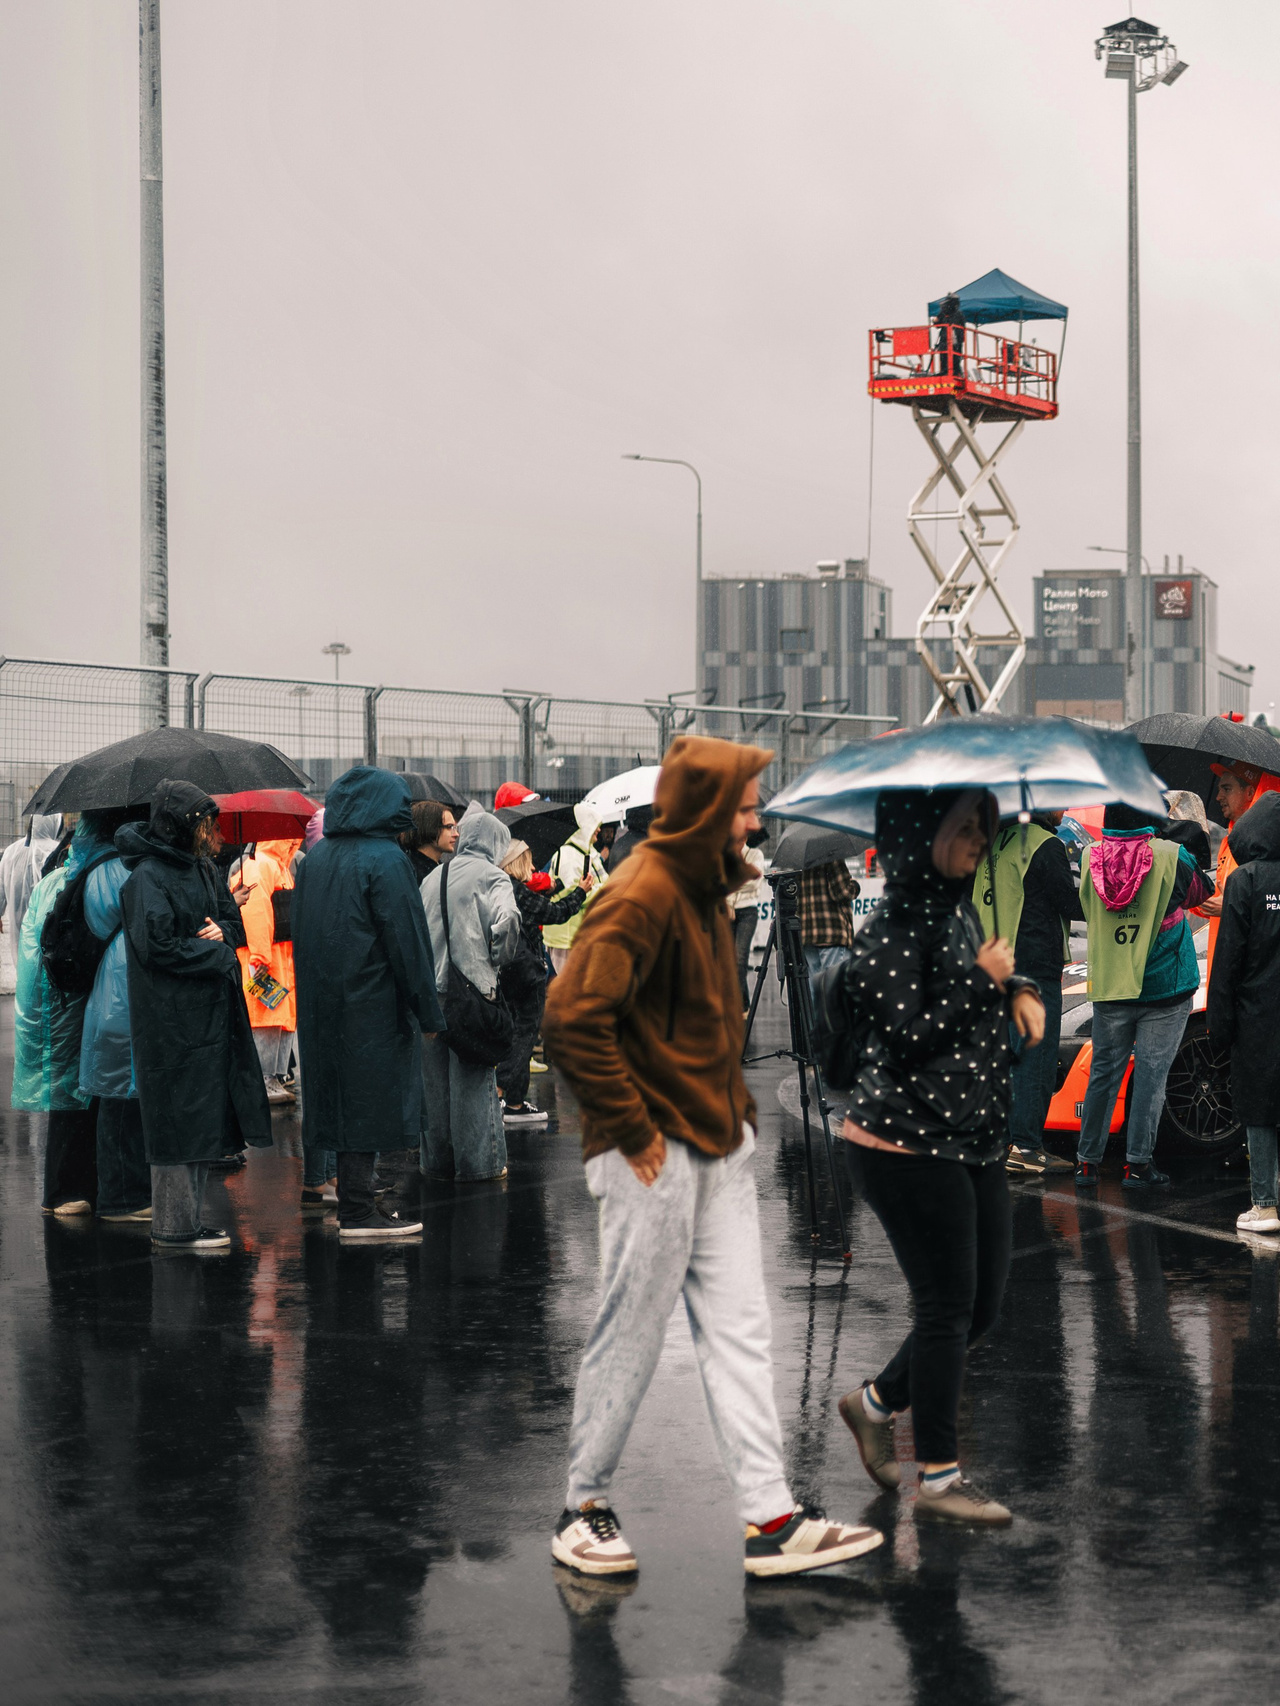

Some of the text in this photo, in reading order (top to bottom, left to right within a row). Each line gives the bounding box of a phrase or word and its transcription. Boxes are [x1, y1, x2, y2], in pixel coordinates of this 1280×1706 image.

[1043, 587, 1109, 598] Ралли Мото
[1043, 601, 1079, 612] Центр
[1114, 924, 1140, 945] 67
